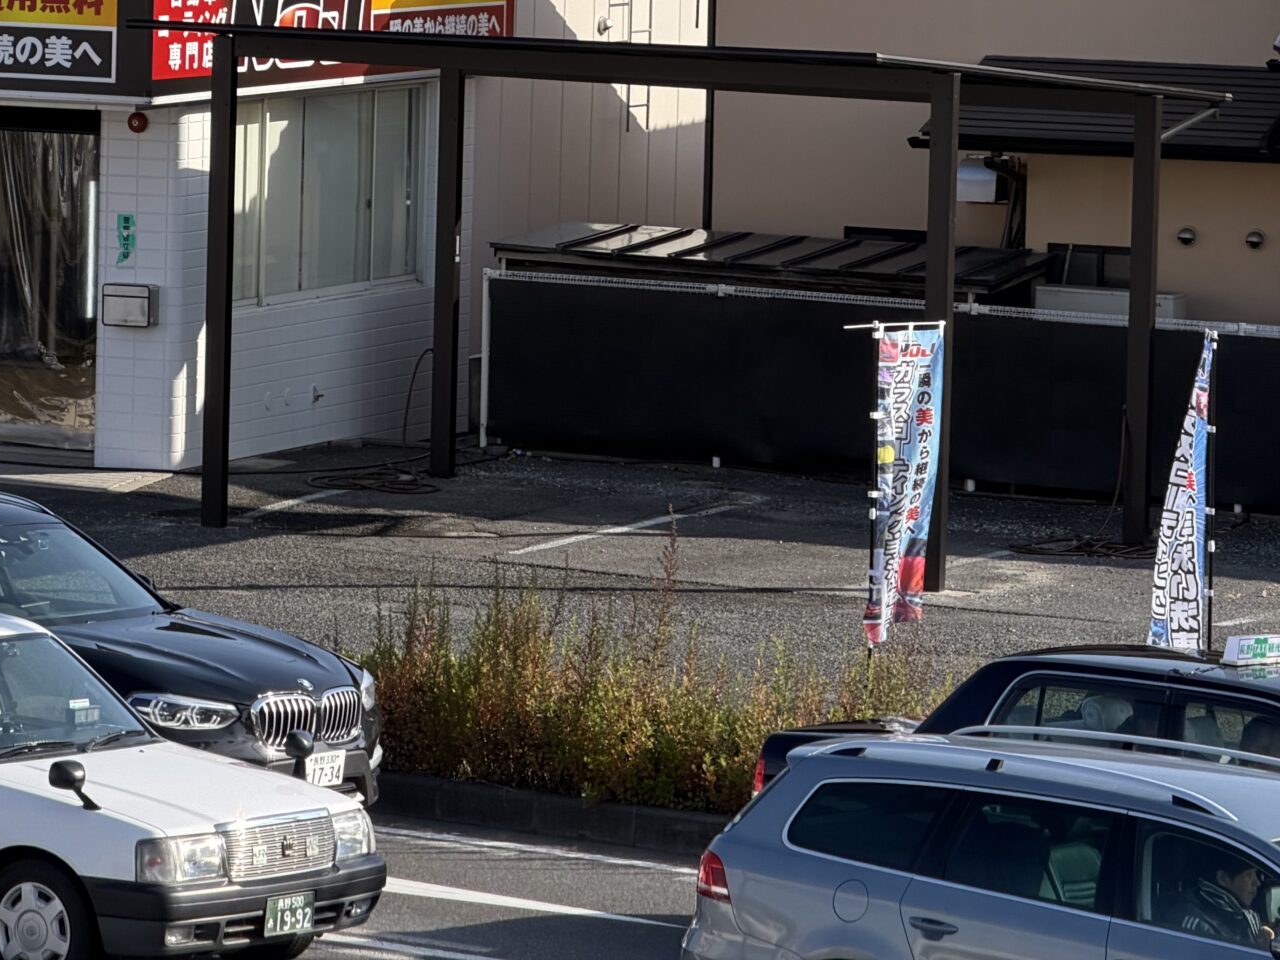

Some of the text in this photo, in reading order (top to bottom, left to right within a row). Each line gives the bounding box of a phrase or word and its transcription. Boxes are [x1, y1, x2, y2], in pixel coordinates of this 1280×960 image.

[384, 11, 501, 36] 瞬の美から継続の美へ
[276, 907, 312, 932] 19-92
